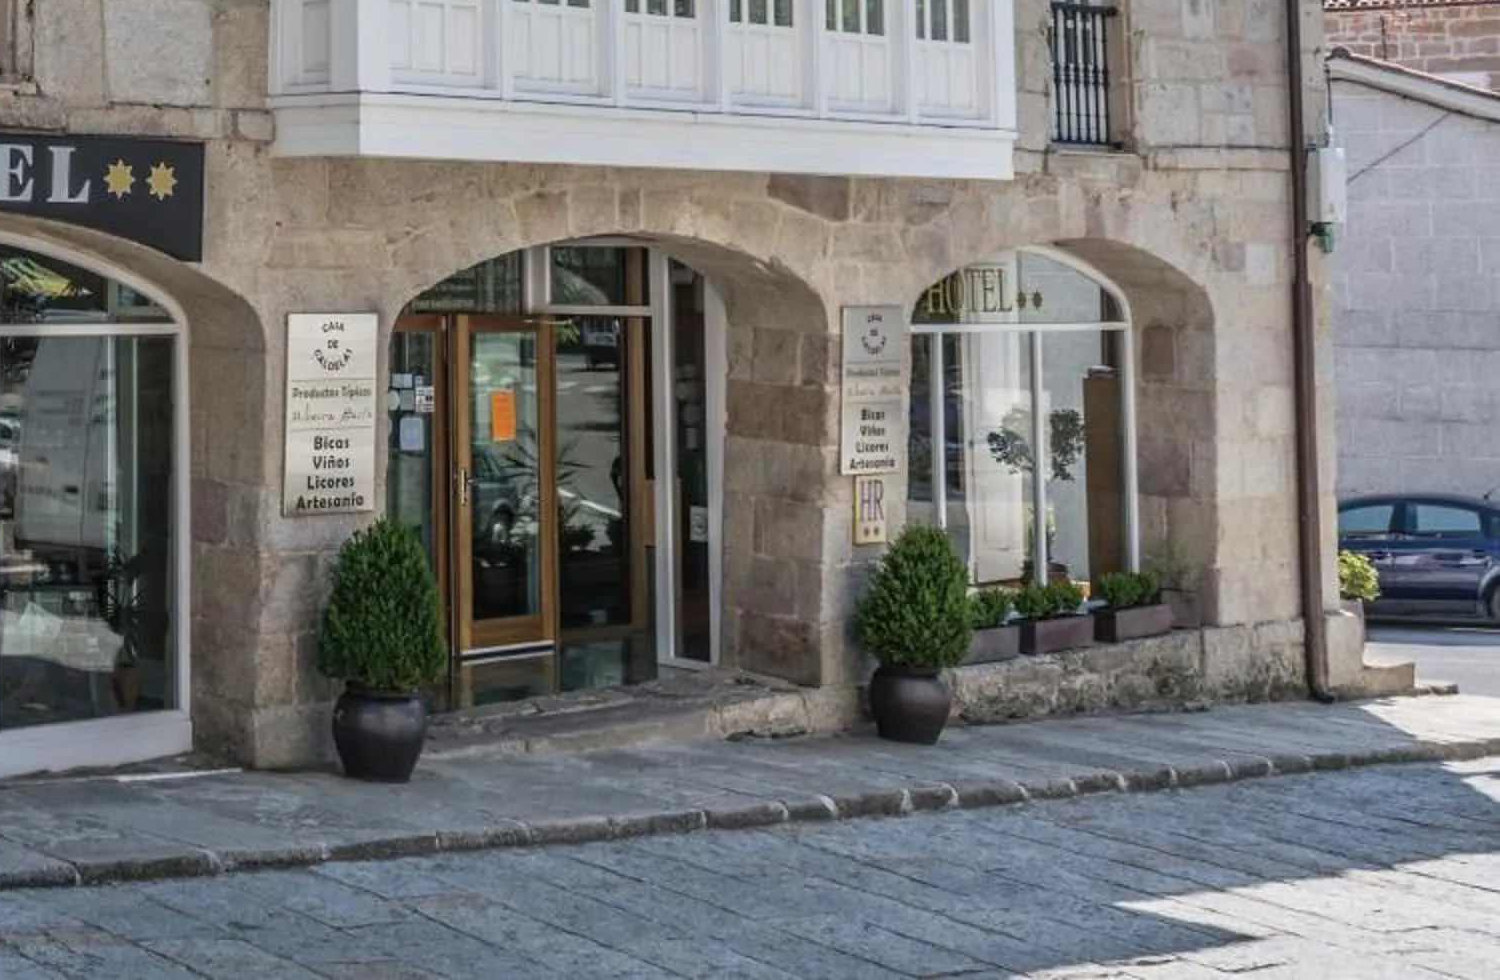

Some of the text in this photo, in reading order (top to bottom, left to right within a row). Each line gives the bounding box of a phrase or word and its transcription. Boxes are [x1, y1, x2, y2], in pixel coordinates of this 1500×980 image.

[327, 339, 339, 349] DE
[313, 436, 350, 450] Bicas
[313, 455, 350, 469] Viños
[307, 475, 355, 490] Licores
[296, 491, 365, 510] Artesanía
[859, 479, 885, 522] HR
